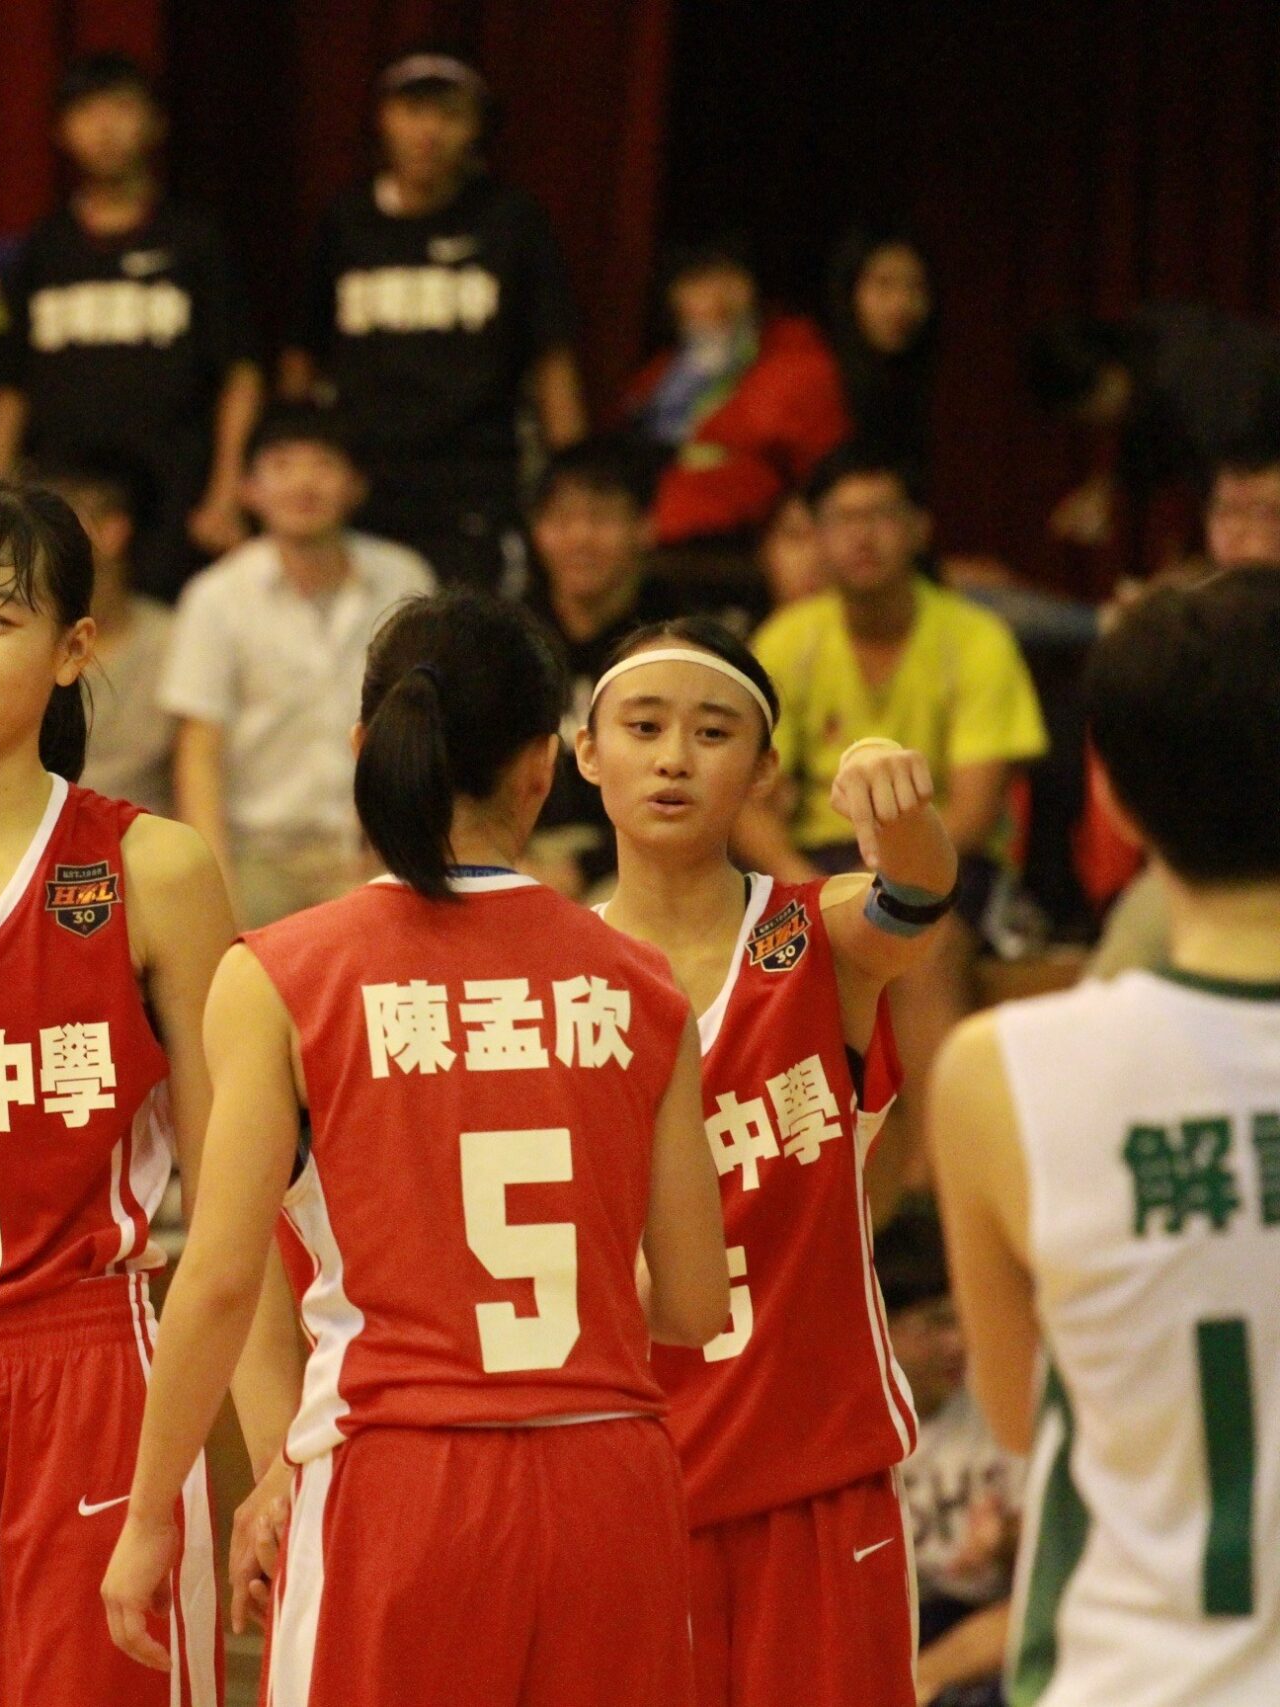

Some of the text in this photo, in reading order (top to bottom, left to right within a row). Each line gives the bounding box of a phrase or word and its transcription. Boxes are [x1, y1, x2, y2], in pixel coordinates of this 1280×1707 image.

[72, 909, 95, 924] 30
[775, 945, 796, 964] 30
[361, 975, 634, 1079] 陳孟欣
[703, 1054, 843, 1192] 中學
[1121, 1110, 1280, 1240] 解
[459, 1127, 581, 1374] 5
[1194, 1317, 1258, 1617] 1
